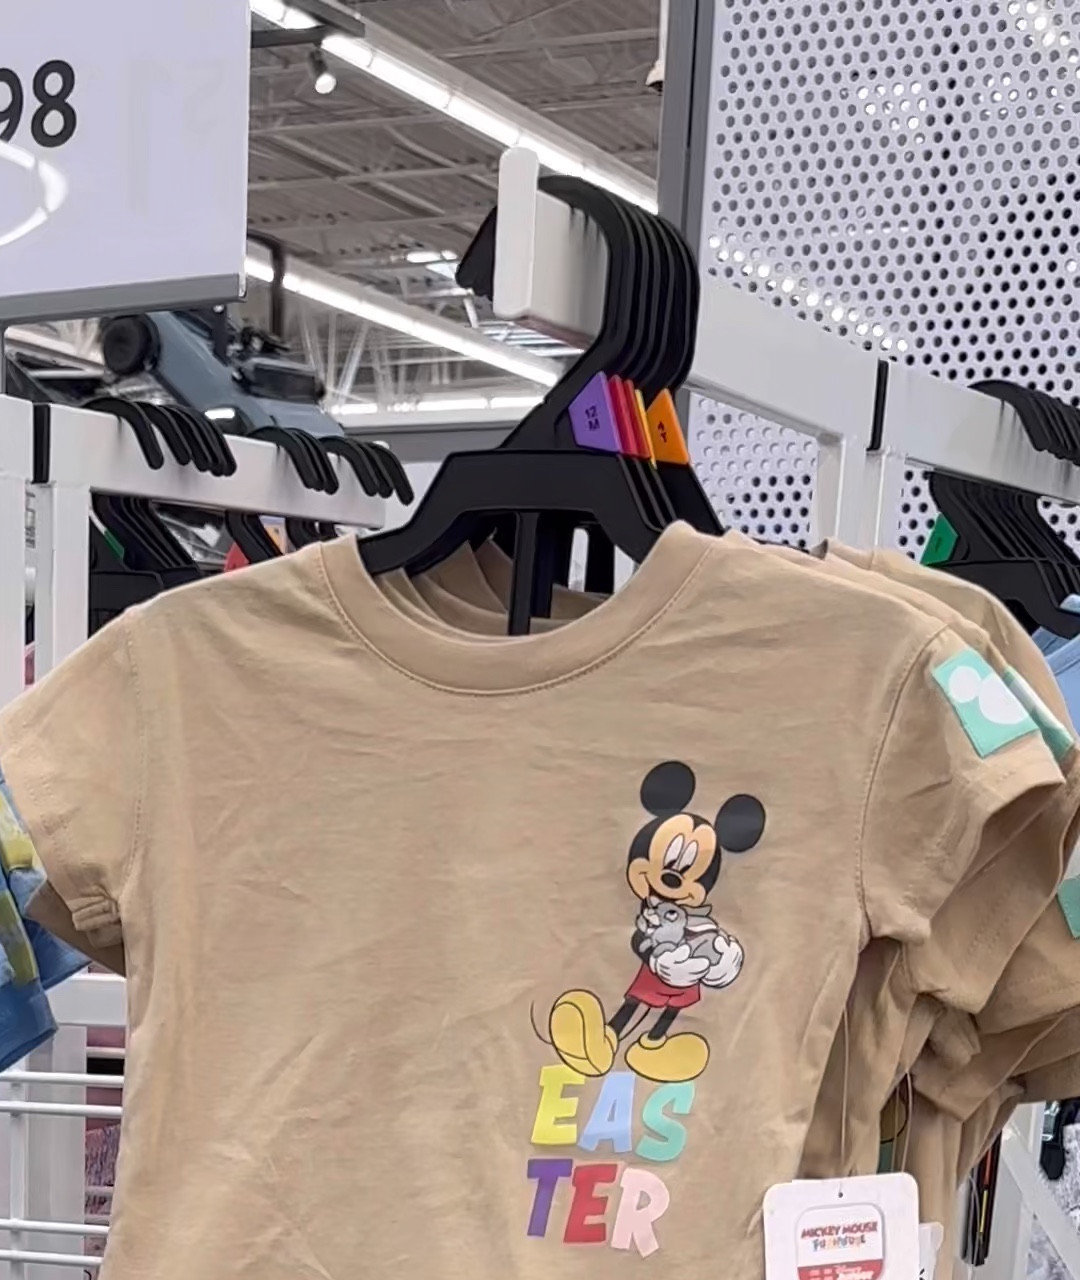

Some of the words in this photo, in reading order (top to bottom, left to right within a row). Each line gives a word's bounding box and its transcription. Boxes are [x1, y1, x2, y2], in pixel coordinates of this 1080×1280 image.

[531, 1064, 695, 1162] EAS
[527, 1158, 670, 1258] TER
[801, 1225, 840, 1239] MICKEY
[841, 1221, 878, 1235] MOUSE
